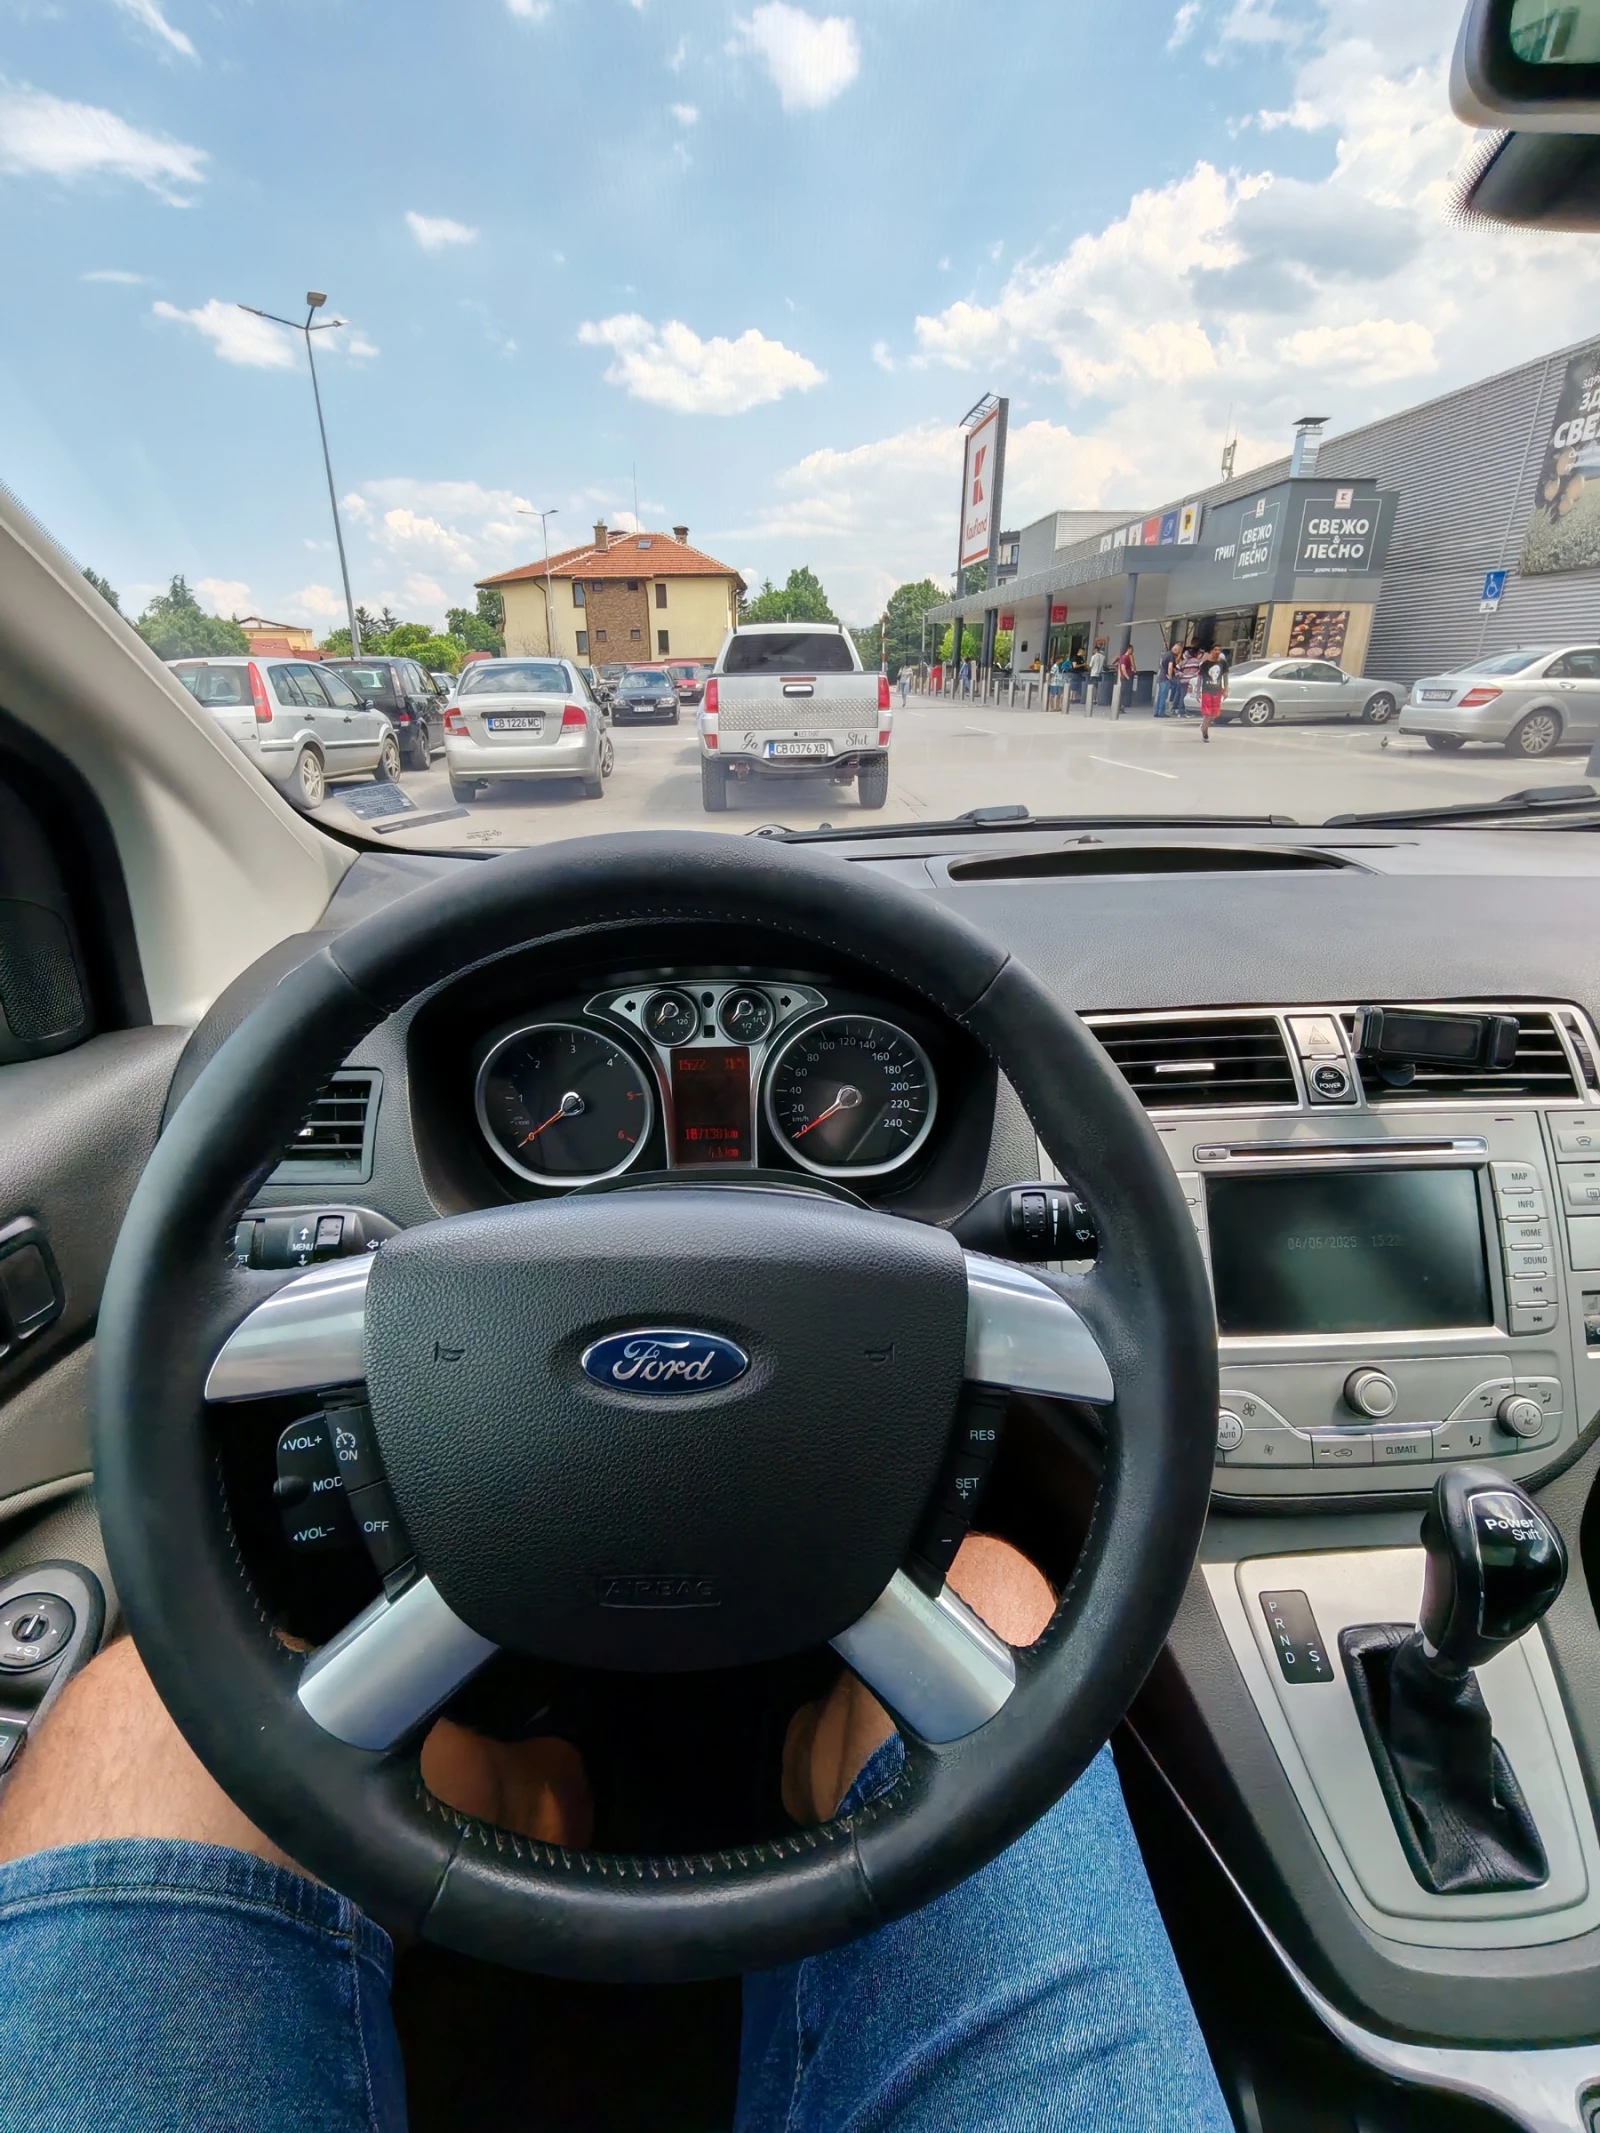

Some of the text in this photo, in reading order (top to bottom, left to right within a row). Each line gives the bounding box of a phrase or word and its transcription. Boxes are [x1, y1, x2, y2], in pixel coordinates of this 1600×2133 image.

[1553, 411, 1600, 449] СВЕ
[965, 512, 989, 542] Kaufland
[1308, 518, 1370, 535] СВЕЖО
[1241, 523, 1273, 545] СВЕЖО
[1332, 535, 1341, 544] &
[1214, 543, 1236, 562] ГРИЛ
[1303, 543, 1365, 559] ЛЕСНО
[1237, 547, 1268, 568] ЛЕСНО
[493, 718, 505, 728] CB
[507, 718, 527, 728] 1226
[775, 743, 826, 754] CB 0376 XB
[819, 1041, 835, 1050] 100
[839, 1037, 857, 1046] 120
[859, 1040, 877, 1050] 140
[570, 1045, 576, 1054] 3
[806, 1053, 820, 1062] 80
[871, 1052, 890, 1061] 160
[534, 1060, 541, 1069] 2
[606, 1058, 613, 1067] 4
[794, 1068, 808, 1077] 60
[883, 1065, 902, 1075] 180
[789, 1086, 802, 1094] 40
[890, 1082, 910, 1091] 200
[626, 1091, 633, 1100] 5
[791, 1103, 805, 1113] 20
[890, 1099, 910, 1109] 220
[883, 1118, 903, 1128] 240
[618, 1130, 625, 1139] 6
[1511, 1172, 1528, 1181] MAP
[1517, 1200, 1535, 1209] INFO
[1520, 1228, 1542, 1237] HOME
[291, 1242, 314, 1252] MENU
[1523, 1256, 1548, 1265] SOUND
[612, 1339, 716, 1381] Ford
[969, 1429, 996, 1441] RES
[1219, 1431, 1236, 1439] AUTO
[288, 1435, 323, 1451] VOL+
[1385, 1445, 1419, 1455] CLIMATE
[338, 1450, 358, 1461] ON
[312, 1476, 343, 1493] MOD
[955, 1477, 980, 1489] SET
[363, 1520, 390, 1533] OFF
[1484, 1518, 1535, 1531] Power
[1511, 1528, 1543, 1541] Shift
[1268, 1601, 1278, 1613] P
[1274, 1617, 1286, 1630] R
[1279, 1634, 1291, 1647] N
[1285, 1651, 1296, 1664] D
[1308, 1650, 1320, 1662] S
